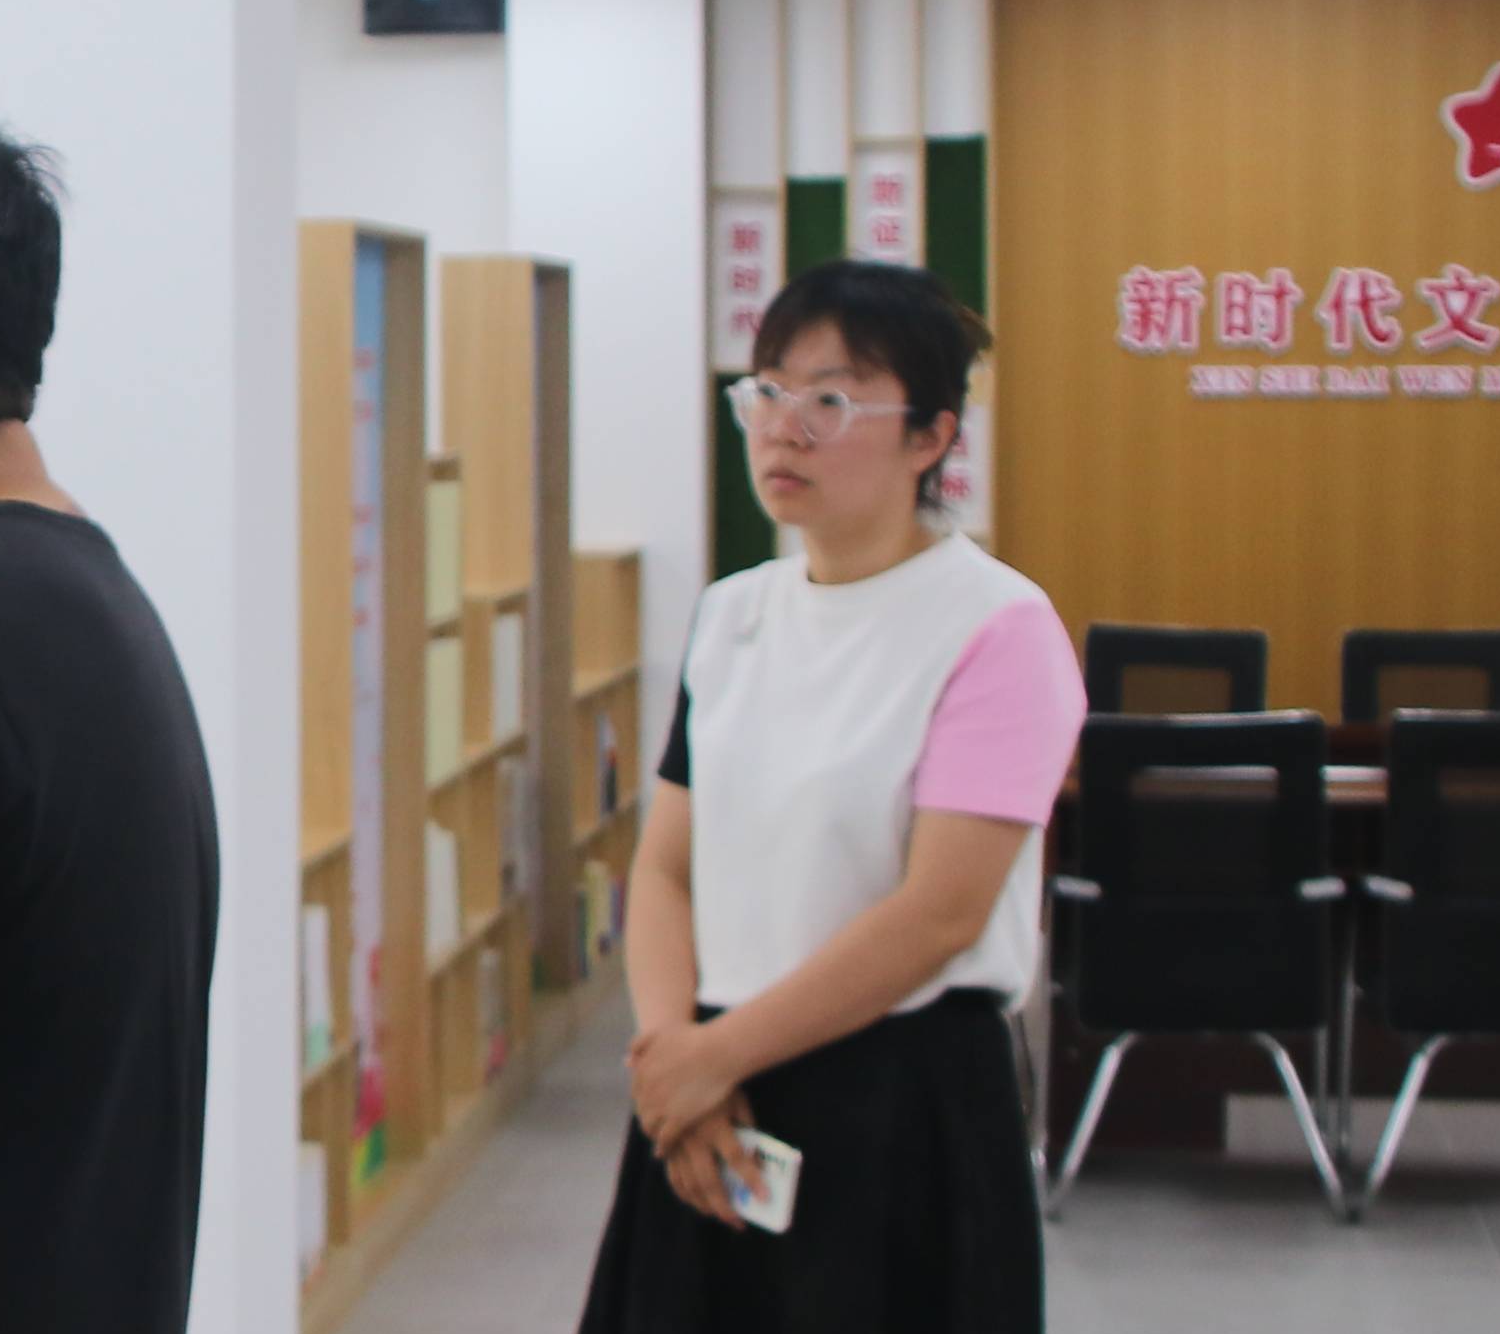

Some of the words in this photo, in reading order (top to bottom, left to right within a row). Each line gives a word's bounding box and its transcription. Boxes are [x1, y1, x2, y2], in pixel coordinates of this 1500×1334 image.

[868, 172, 906, 259] 新征
[1191, 365, 1256, 398] XIN
[1258, 365, 1320, 398] SHI
[1324, 365, 1391, 398] DAI
[1397, 365, 1474, 398] WEN
